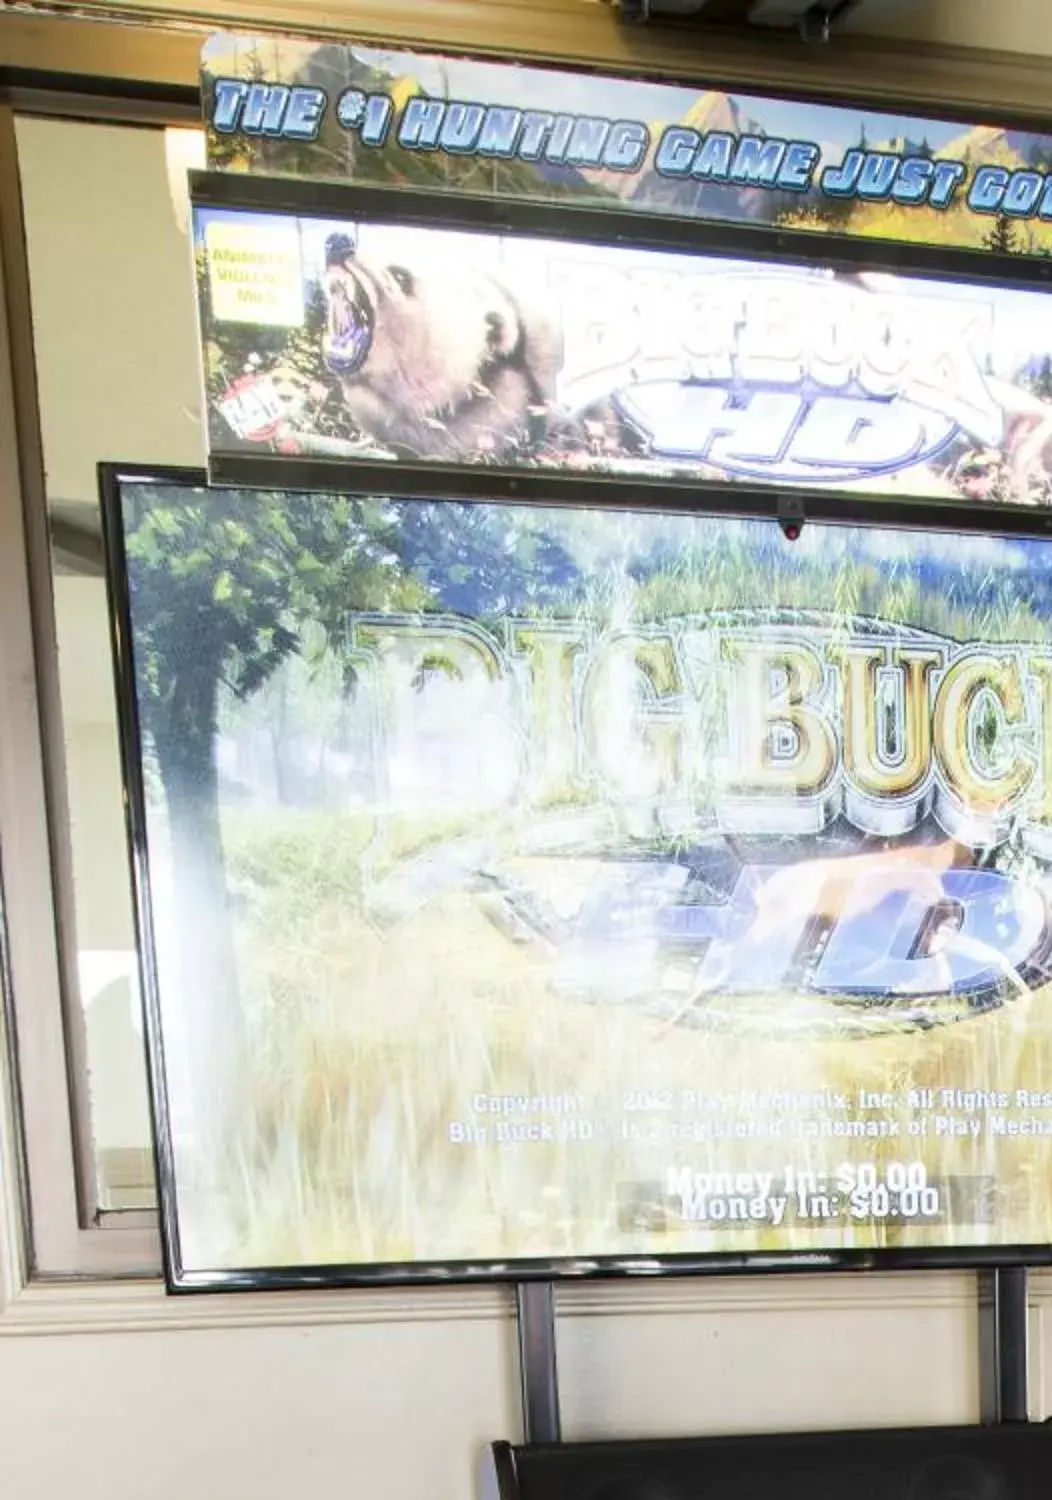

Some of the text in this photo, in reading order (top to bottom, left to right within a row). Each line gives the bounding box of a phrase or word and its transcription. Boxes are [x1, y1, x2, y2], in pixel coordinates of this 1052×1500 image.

[211, 76, 325, 142] THE
[337, 87, 393, 148] #1
[398, 93, 650, 174] HUNTING
[653, 124, 821, 193] GAME
[822, 147, 963, 209] JUST
[346, 612, 695, 820] BIG
[907, 1087, 934, 1108] All
[942, 1087, 1010, 1111] Rights
[449, 1121, 487, 1146] Big
[496, 1121, 555, 1141] Buck
[907, 1118, 927, 1136] of
[935, 1116, 980, 1138] Play
[665, 1161, 927, 1201] Money In: $0.00
[680, 1185, 940, 1225] Money In: $0.00
